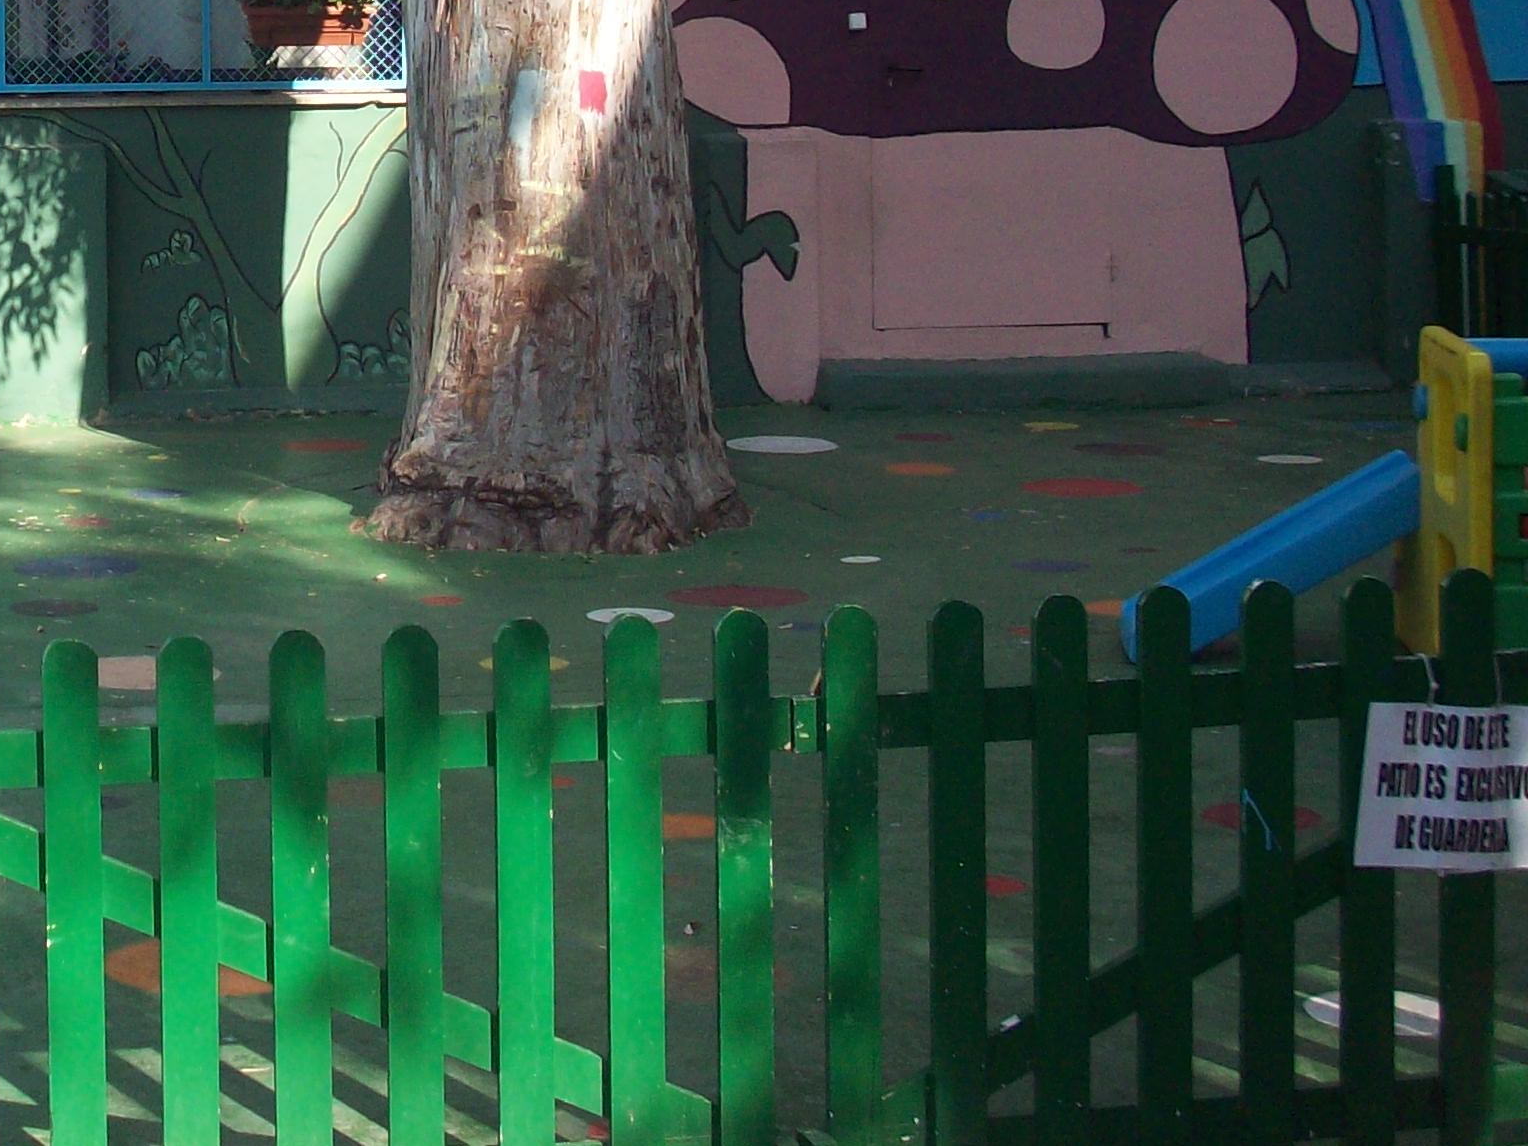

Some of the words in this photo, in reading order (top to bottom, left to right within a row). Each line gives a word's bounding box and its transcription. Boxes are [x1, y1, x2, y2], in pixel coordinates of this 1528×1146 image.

[1403, 711, 1417, 745] EL
[1421, 710, 1459, 750] USO
[1463, 715, 1484, 750] DE
[1376, 762, 1421, 798] PATIO
[1425, 763, 1448, 799] ES
[1395, 815, 1416, 849] DE
